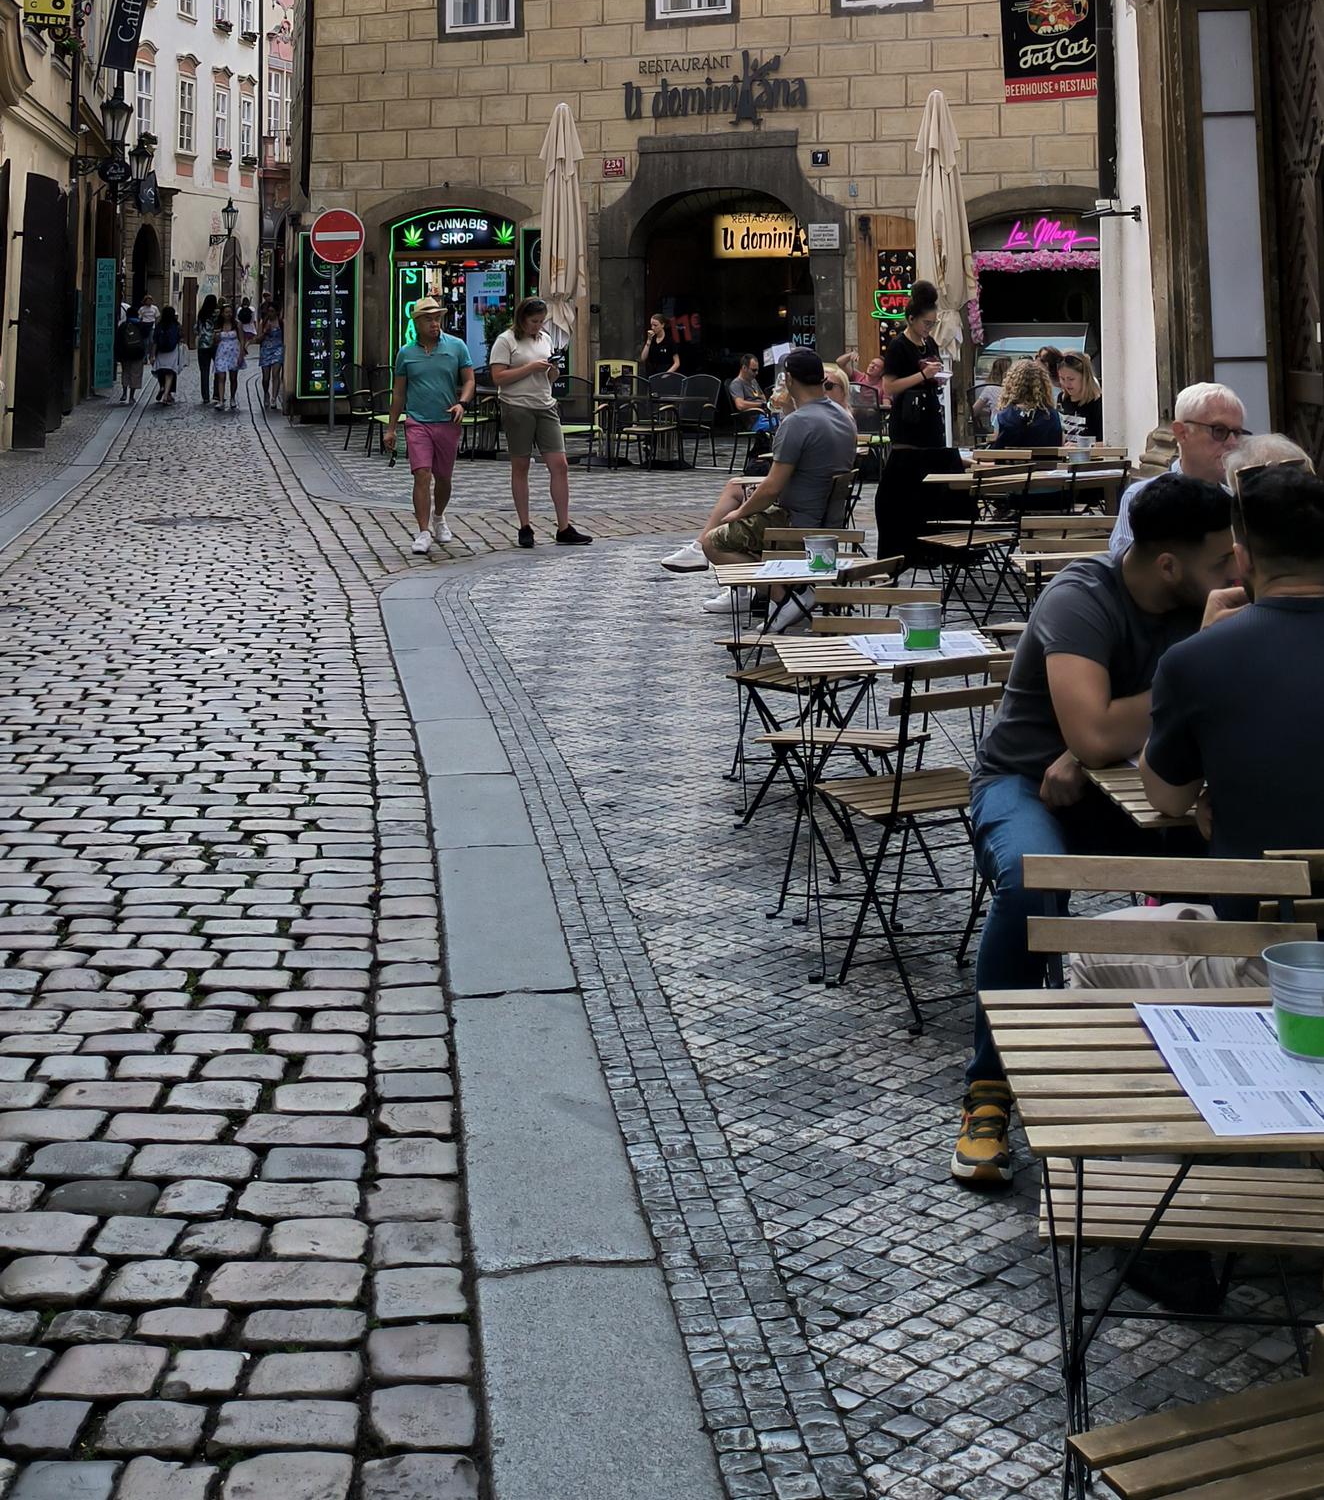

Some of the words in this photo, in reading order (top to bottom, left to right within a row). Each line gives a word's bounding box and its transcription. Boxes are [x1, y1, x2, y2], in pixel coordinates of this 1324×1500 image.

[26, 14, 67, 25] ALIEN
[1019, 40, 1058, 69] Fat
[1055, 37, 1097, 65] Cat
[638, 54, 733, 75] RESTAURANT
[1005, 81, 1055, 97] BEERHOUSE
[817, 153, 823, 163] 7
[606, 160, 621, 169] 234
[428, 218, 489, 231] CANNABIS
[732, 213, 788, 224] RESTAURANT
[440, 233, 474, 244] SHOP
[1002, 221, 1032, 249] La
[1033, 218, 1098, 252] Mary
